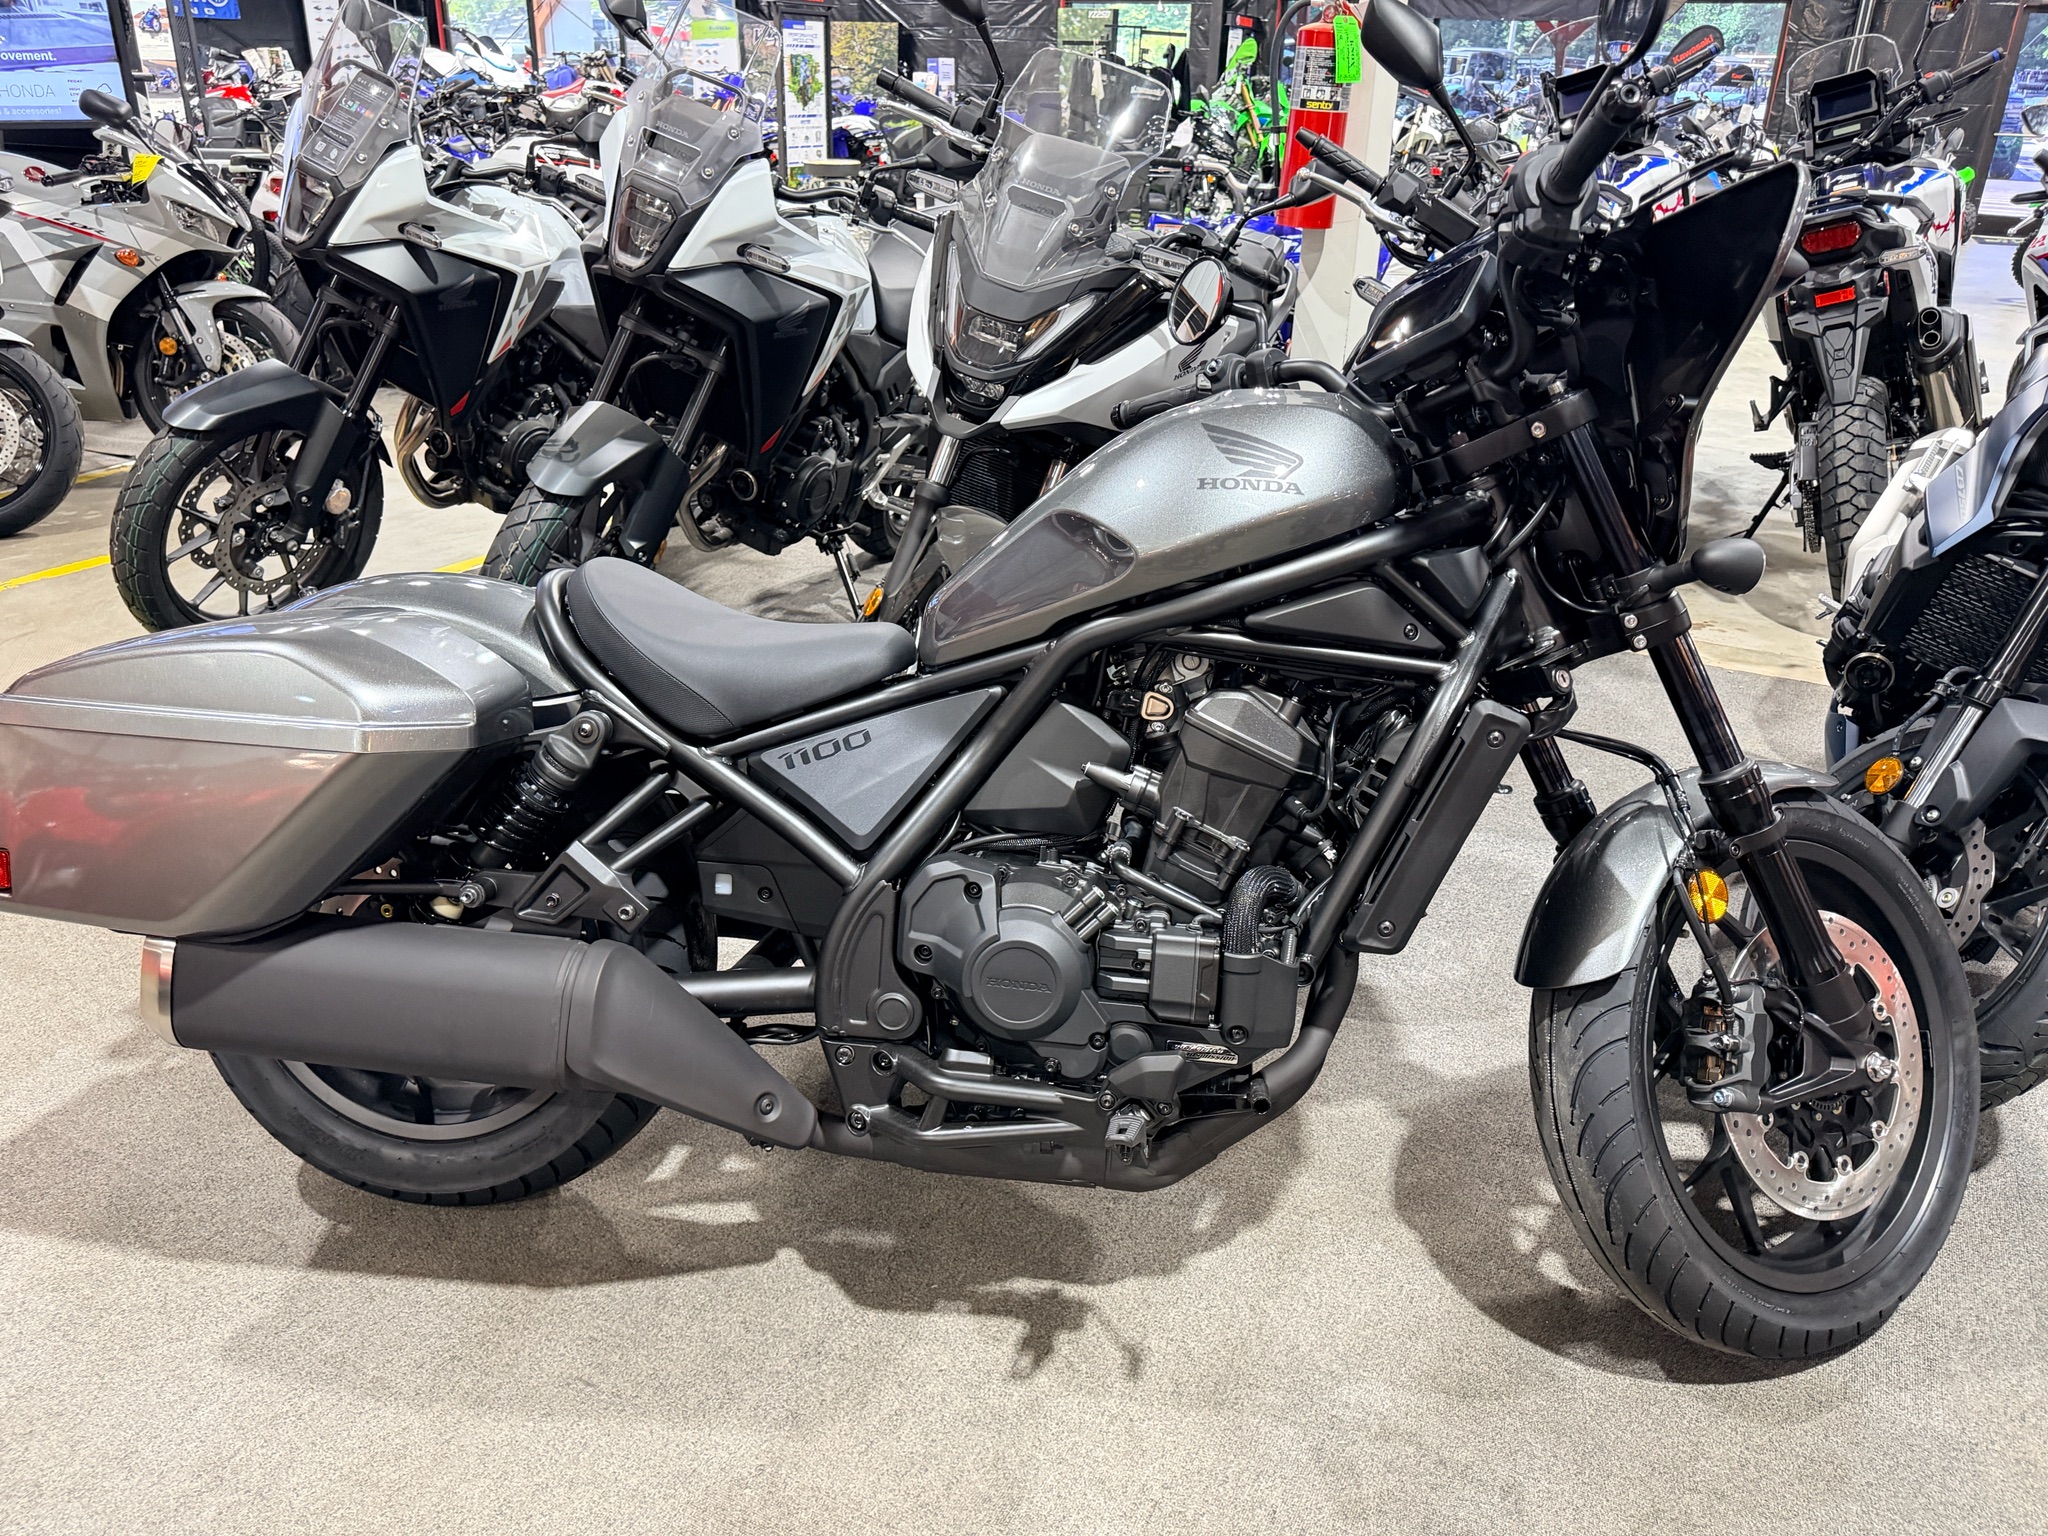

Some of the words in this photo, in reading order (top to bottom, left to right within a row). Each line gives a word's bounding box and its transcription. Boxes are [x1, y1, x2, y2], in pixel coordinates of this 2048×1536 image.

[1672, 34, 1715, 64] Kawasaki
[1306, 100, 1334, 110] sentry
[655, 120, 690, 139] HONDA
[1021, 178, 1062, 197] HONDA
[1196, 477, 1306, 496] HONDA
[777, 728, 872, 770] 1100
[985, 977, 1053, 994] HONDA
